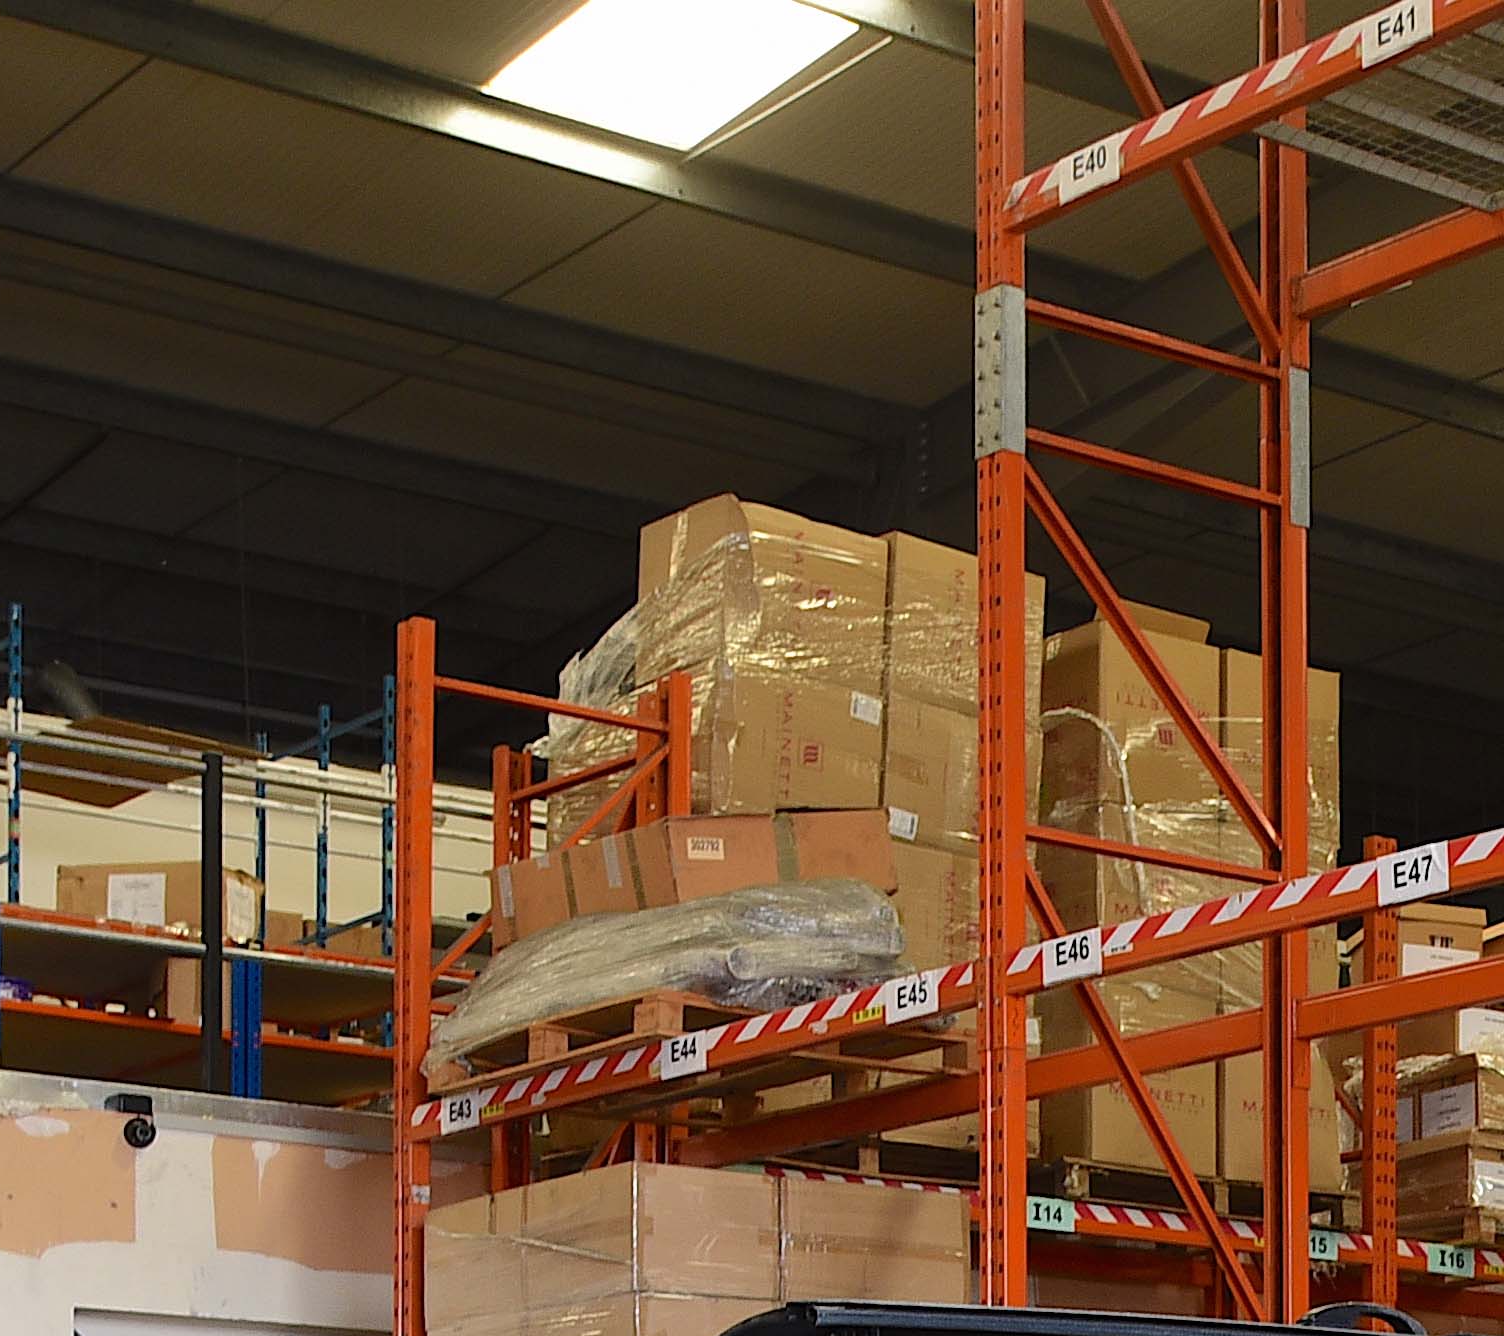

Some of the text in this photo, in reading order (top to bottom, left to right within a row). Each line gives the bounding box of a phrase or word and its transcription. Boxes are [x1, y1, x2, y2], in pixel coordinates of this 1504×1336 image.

[1377, 6, 1416, 47] E41
[1072, 144, 1107, 181] E40
[1392, 855, 1434, 887] E47
[1055, 936, 1090, 967] E46
[897, 979, 928, 1009] E45
[671, 1038, 697, 1063] E44
[449, 1099, 472, 1122] E43
[1309, 1235, 1328, 1254] 15
